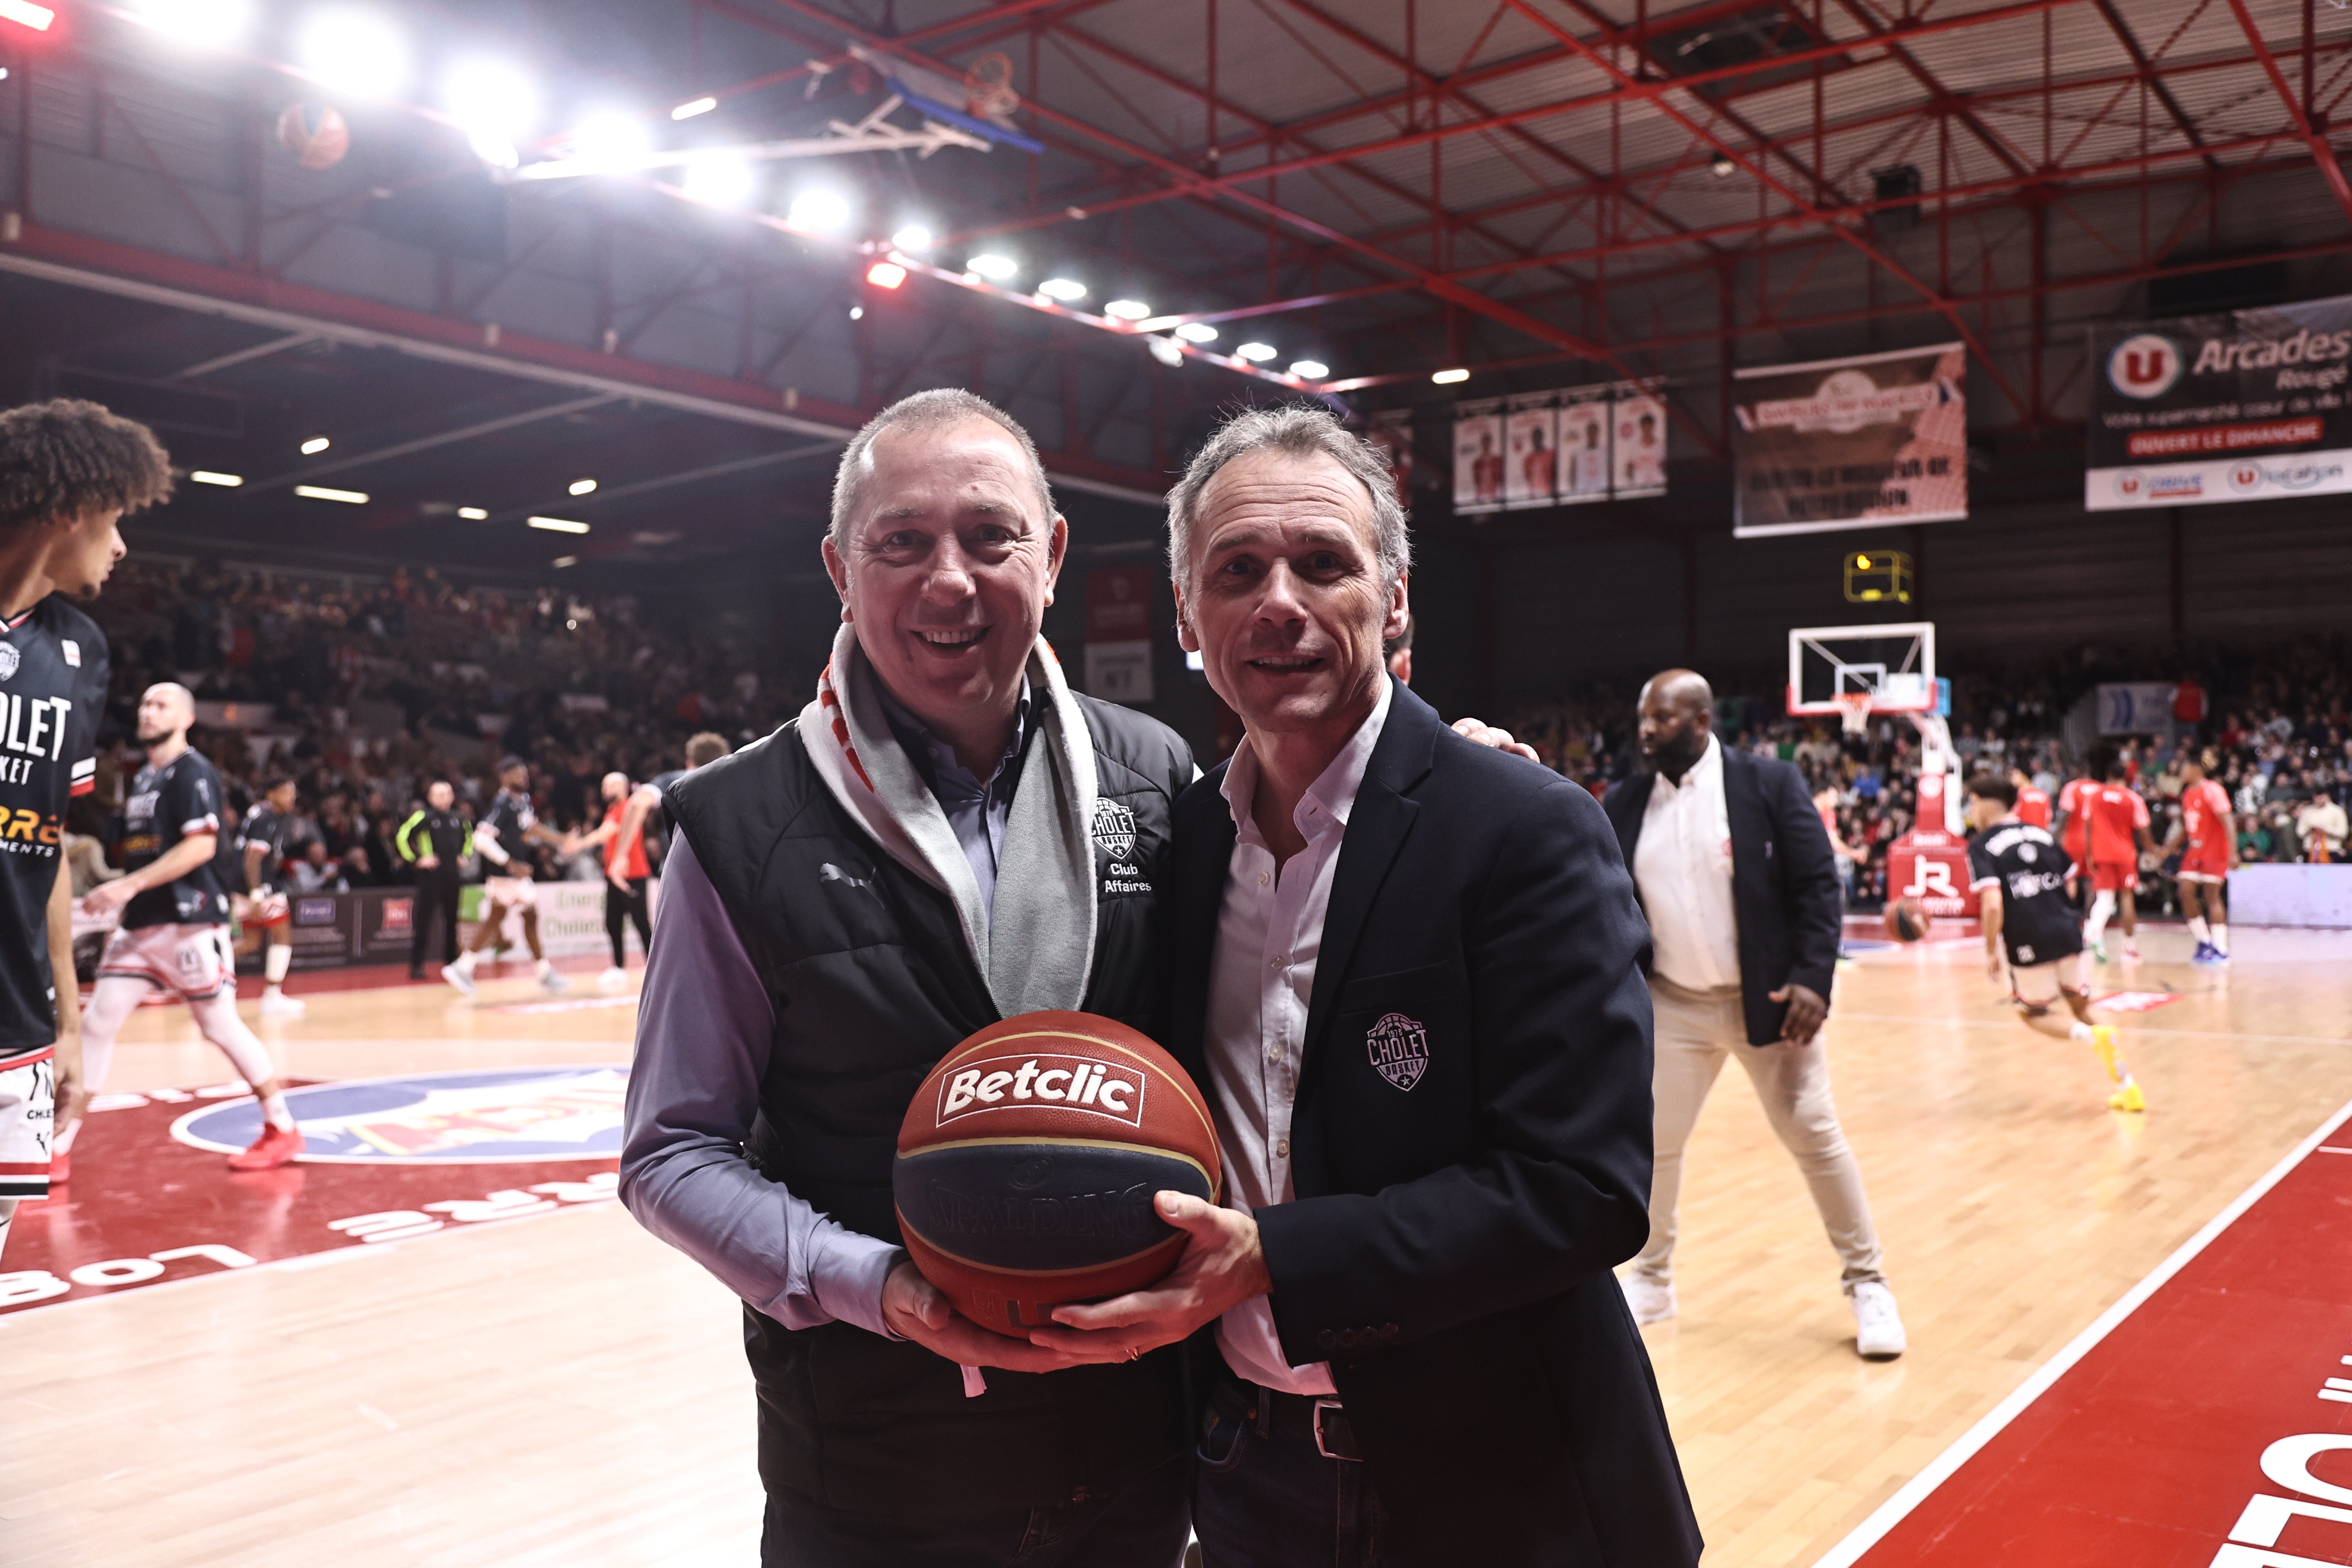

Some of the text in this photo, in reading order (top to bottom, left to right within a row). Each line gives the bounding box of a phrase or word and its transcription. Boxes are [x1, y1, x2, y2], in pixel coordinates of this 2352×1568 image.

[2125, 350, 2164, 386] U
[2191, 328, 2352, 375] Arcades
[2130, 422, 2318, 455] OUVERT LE DIMANCHE
[1102, 836, 1131, 845] BASKET
[1110, 863, 1138, 875] Club
[1105, 880, 1152, 893] Affaires
[1367, 1029, 1430, 1066] CHOLET
[1387, 1029, 1403, 1039] 1975
[1385, 1060, 1420, 1076] BASKET
[943, 1059, 1135, 1116] Betclic
[928, 1178, 1152, 1239] SPALDING
